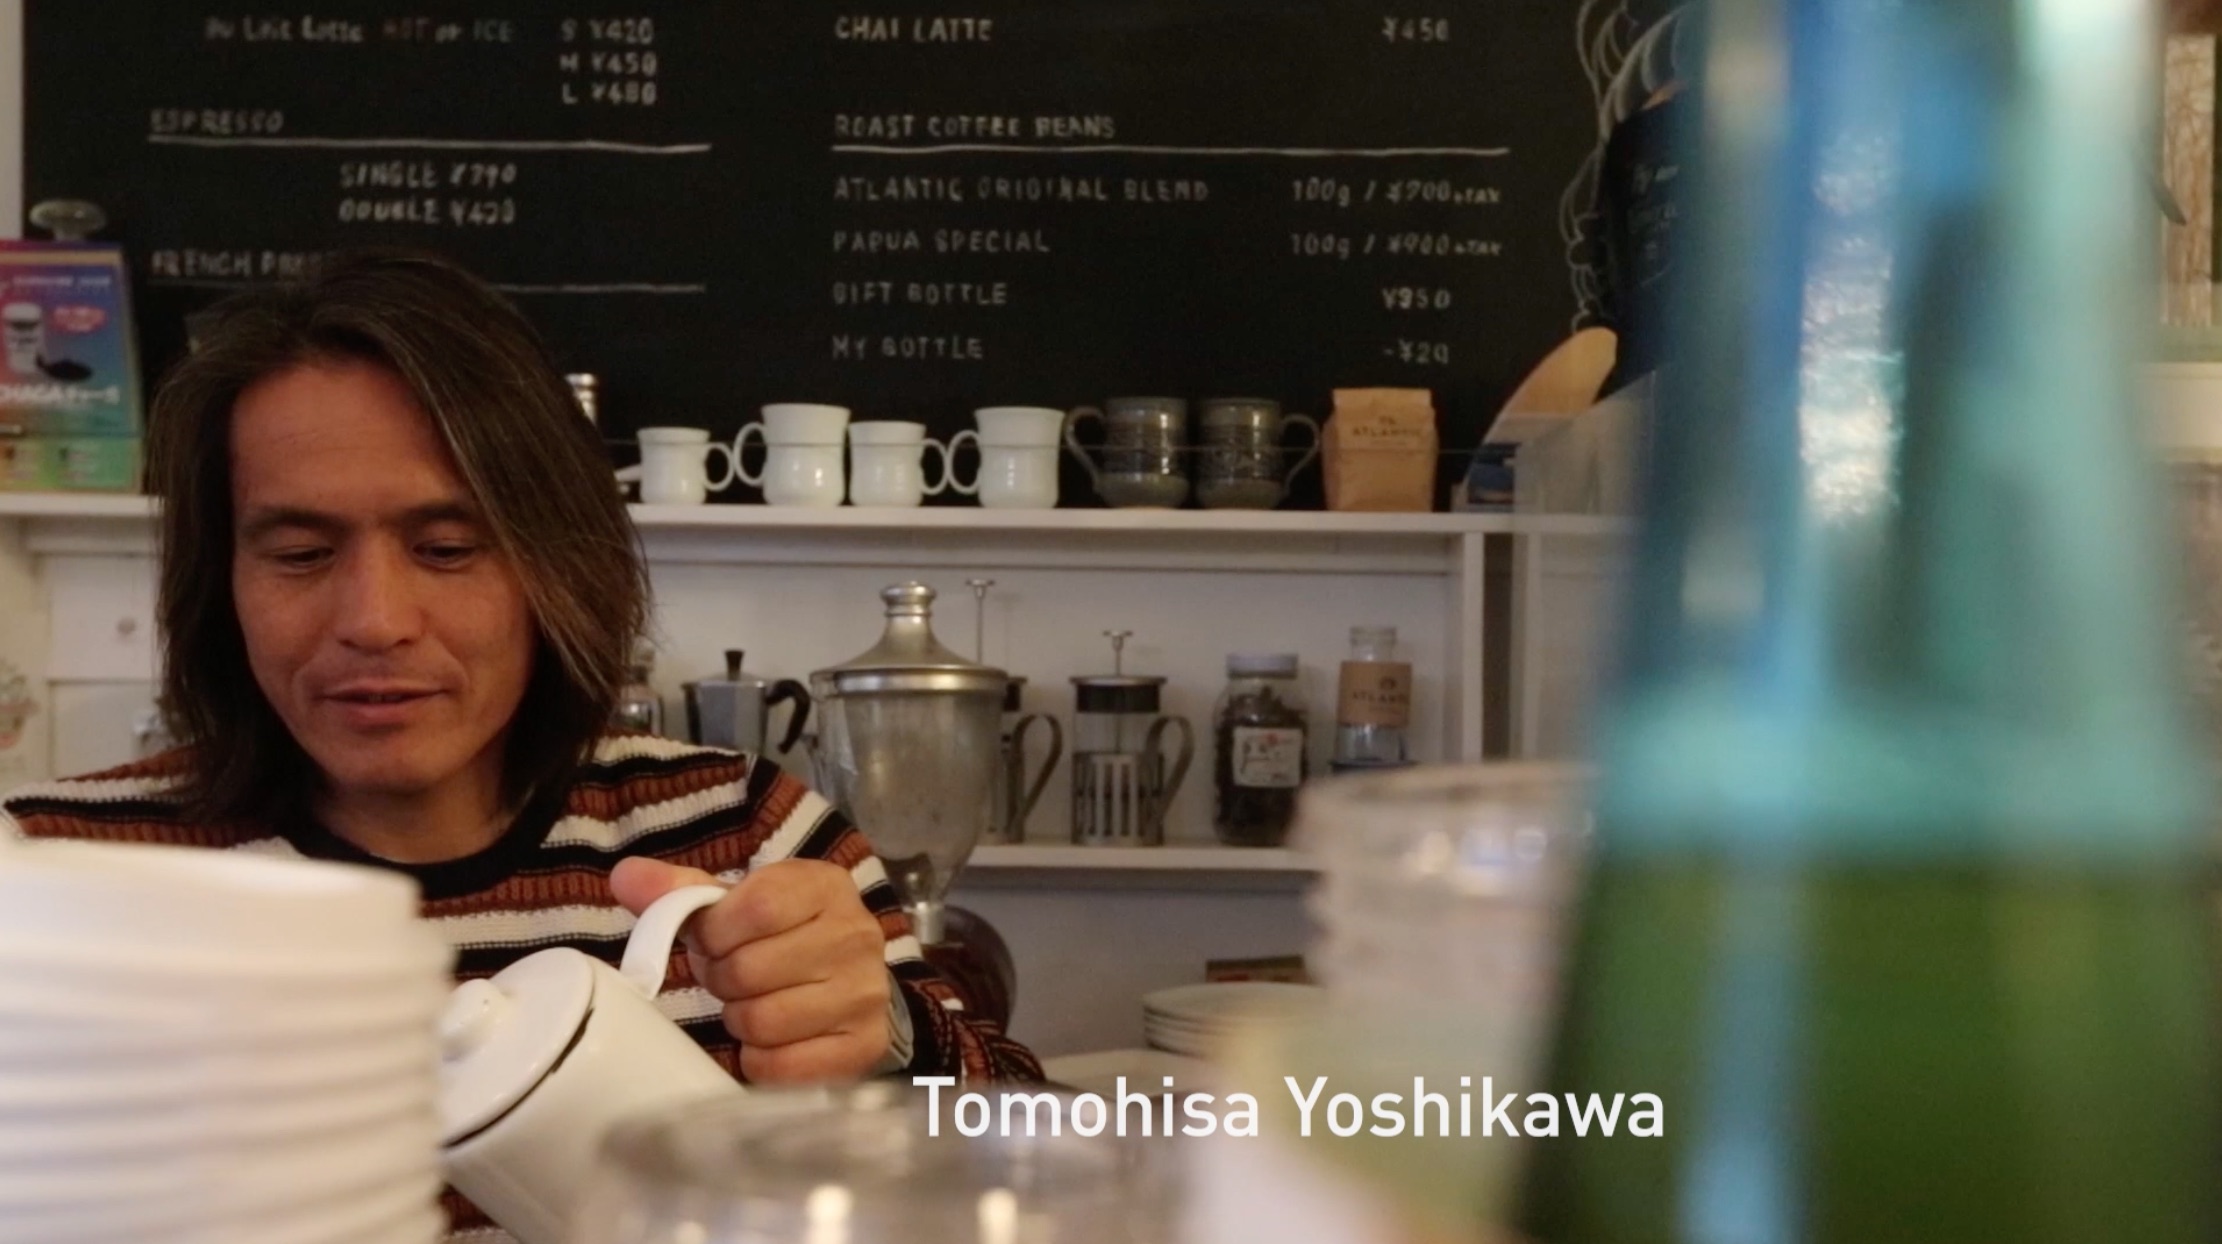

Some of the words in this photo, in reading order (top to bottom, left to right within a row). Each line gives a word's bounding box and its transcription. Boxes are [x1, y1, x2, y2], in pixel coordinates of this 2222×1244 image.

[473, 20, 513, 43] ICE
[834, 16, 900, 41] CHAI
[912, 17, 994, 42] LATTE
[559, 52, 579, 72] M
[591, 51, 659, 77] ¥450
[562, 83, 579, 105] L
[150, 109, 284, 135] ESPRESSO
[834, 114, 916, 139] ROAST
[926, 115, 1021, 138] COFFEE
[1033, 115, 1117, 138] BEANS
[339, 161, 437, 189] SINGLE
[833, 176, 965, 202] ATLANTIC
[977, 176, 1108, 202] ORIGINAL
[1123, 178, 1209, 203] BLEND
[1292, 176, 1351, 208] 100g
[338, 198, 438, 224] DOUBLE
[832, 229, 920, 253] PAPUA
[933, 228, 1051, 254] SPECIAL
[1290, 231, 1351, 260] 100g
[151, 250, 252, 277] FRENCH
[832, 281, 893, 305] GIFT
[906, 281, 1008, 306] BOTTLE
[831, 335, 867, 359] MY
[880, 335, 984, 359] BOTTLE
